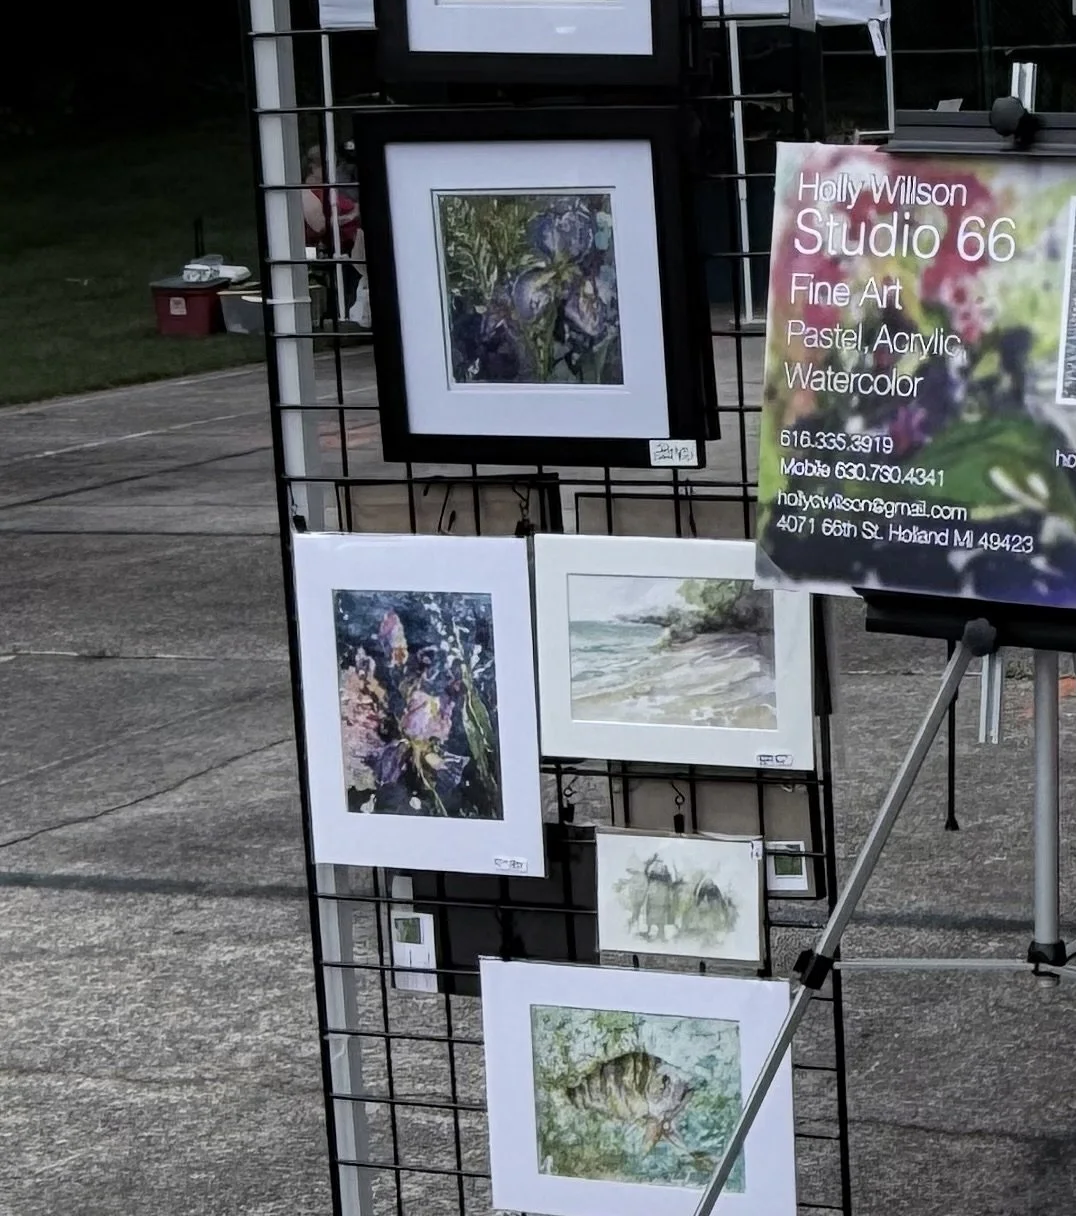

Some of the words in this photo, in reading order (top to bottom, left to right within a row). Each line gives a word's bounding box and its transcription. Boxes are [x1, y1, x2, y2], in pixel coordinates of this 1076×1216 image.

[798, 172, 864, 209] Holly
[871, 173, 967, 207] Willson
[794, 207, 940, 259] Studio
[957, 215, 1016, 262] 66
[790, 273, 850, 307] Fine
[859, 276, 903, 310] Art
[787, 319, 869, 354] Pastel,
[784, 361, 925, 398] Watercolor
[780, 429, 894, 455] 616.335.3919
[780, 457, 831, 478] Mobile
[776, 515, 815, 535] 4071
[821, 519, 857, 538] 66th
[888, 523, 949, 547] Holland
[954, 529, 973, 549] MI
[978, 532, 1034, 554] 49423
